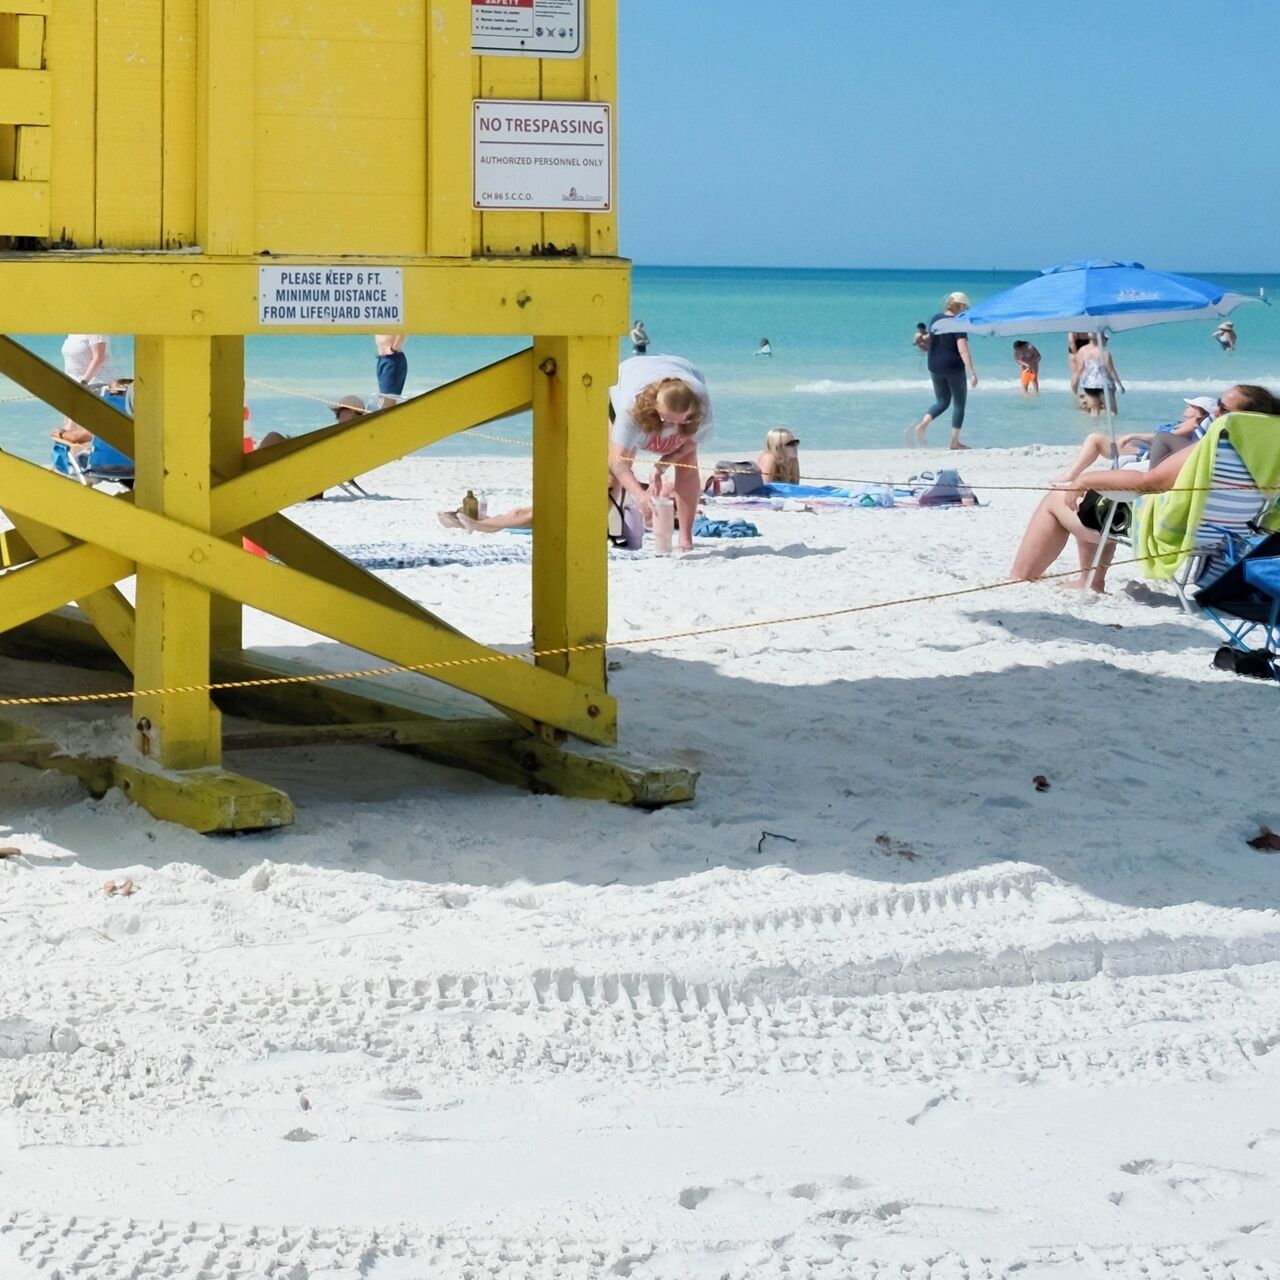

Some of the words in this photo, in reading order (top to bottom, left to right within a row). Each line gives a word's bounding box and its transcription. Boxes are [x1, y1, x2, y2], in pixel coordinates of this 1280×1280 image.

[480, 118, 502, 132] NO
[506, 118, 604, 135] TRESPASSING
[480, 156, 532, 166] AUTHORIZED
[534, 158, 580, 166] PERSONNEL
[583, 158, 603, 167] ONLY
[482, 192, 492, 200] CH
[281, 273, 322, 285] PLEASE
[325, 273, 353, 285] KEEP
[357, 273, 363, 285] 6
[367, 273, 382, 285] FT.
[276, 289, 330, 302] MINIMUM
[334, 289, 387, 302] DISTANCE
[263, 306, 296, 319] FROM
[300, 306, 361, 319] LIFEGUARD
[364, 306, 398, 319] STAND
